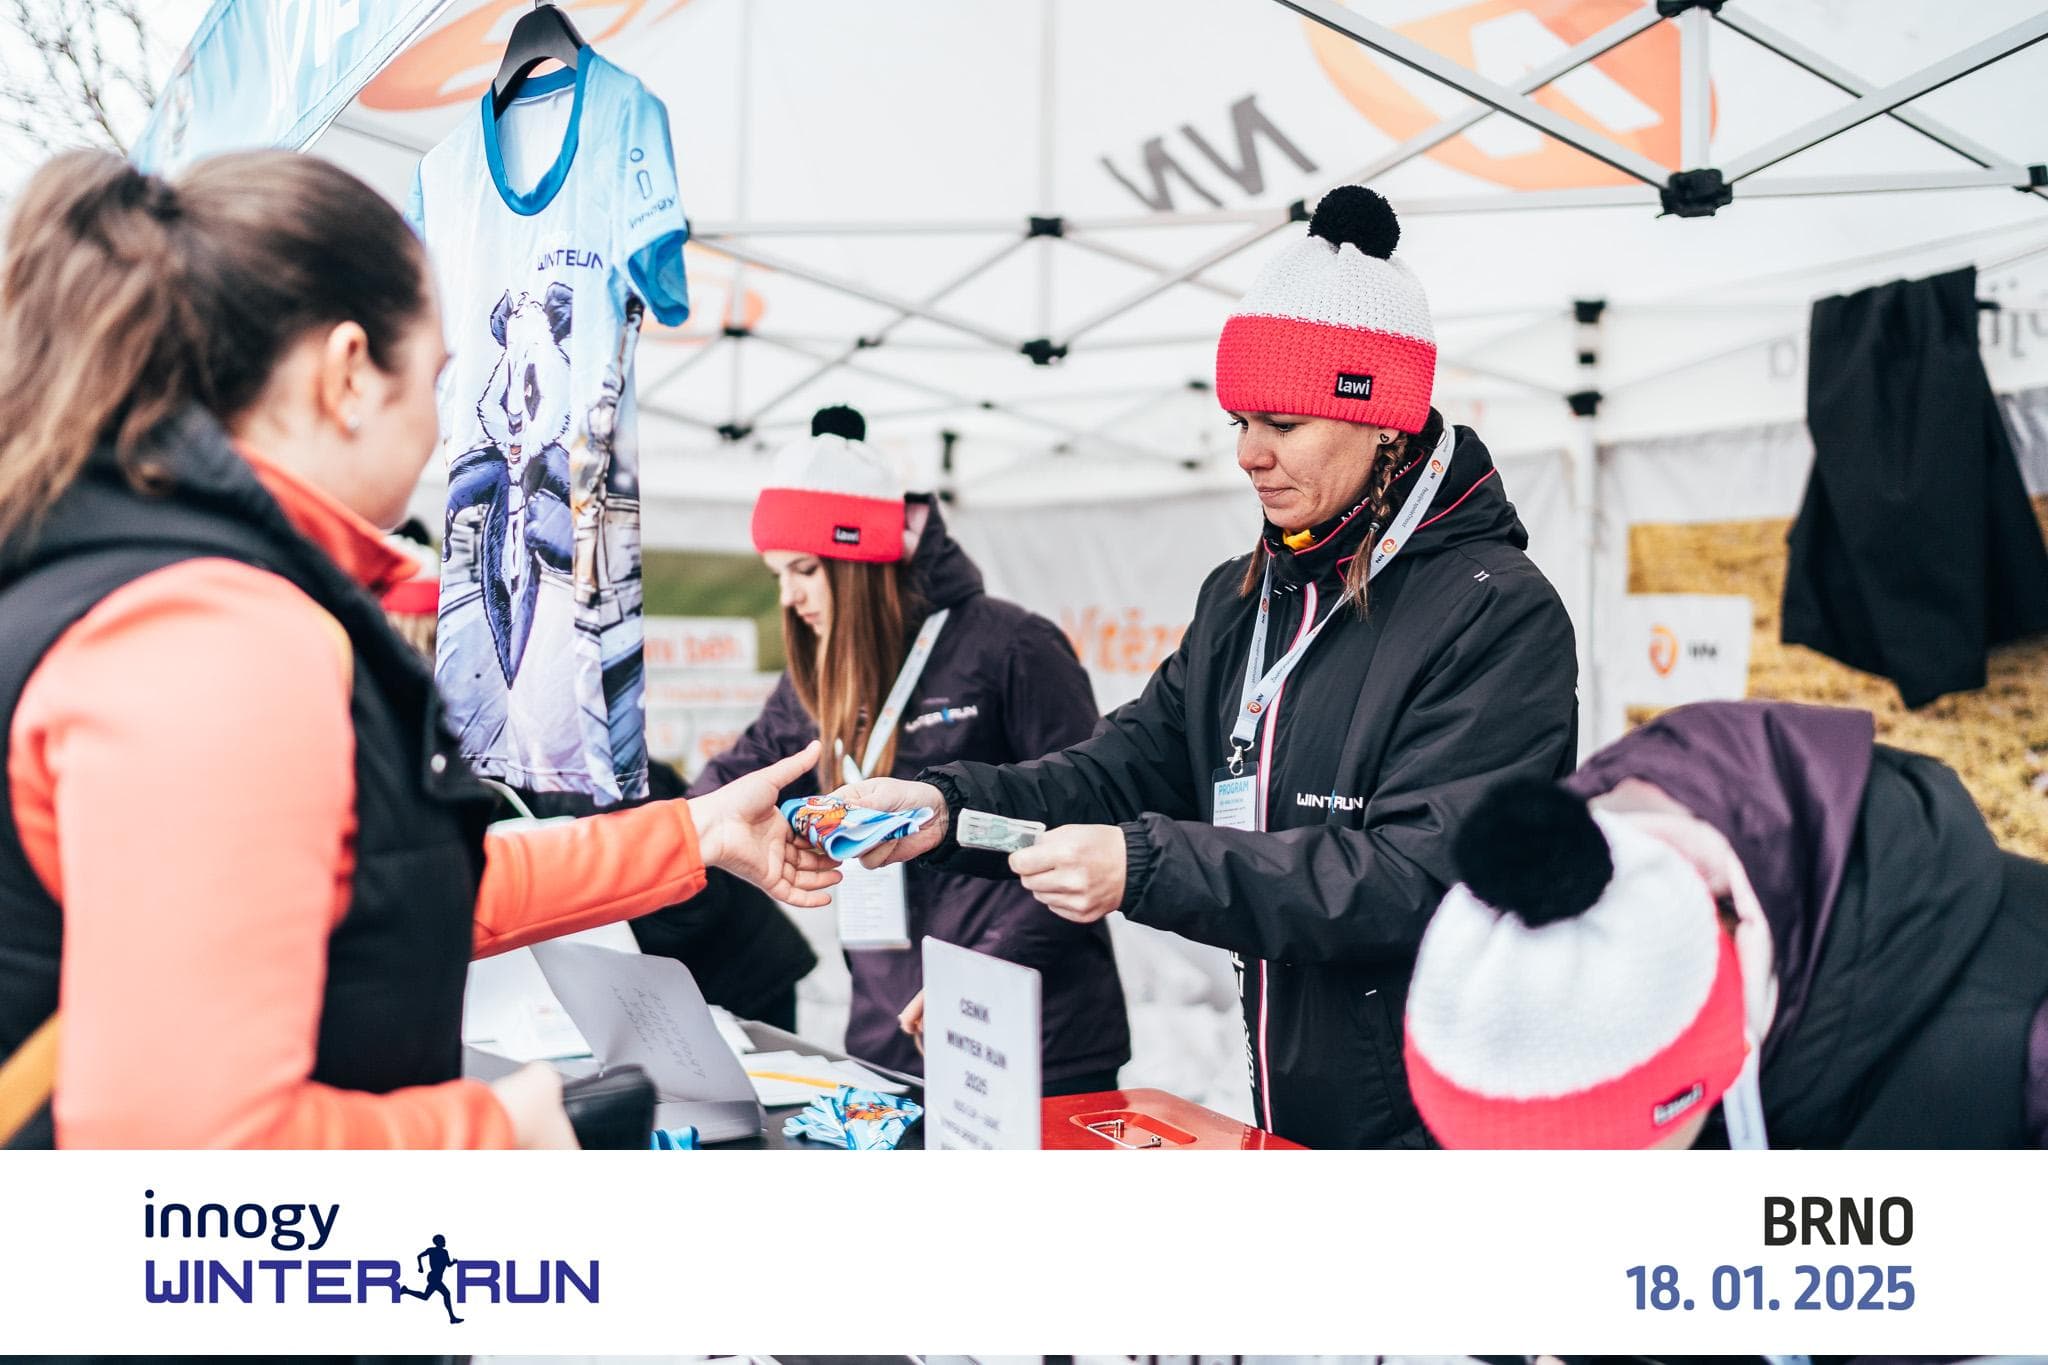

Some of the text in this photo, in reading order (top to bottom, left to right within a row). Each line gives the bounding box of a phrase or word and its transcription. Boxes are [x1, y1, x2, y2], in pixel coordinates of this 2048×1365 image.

[1338, 376, 1371, 395] lawi
[1375, 554, 1384, 563] NN
[1218, 780, 1249, 796] PROGRAM
